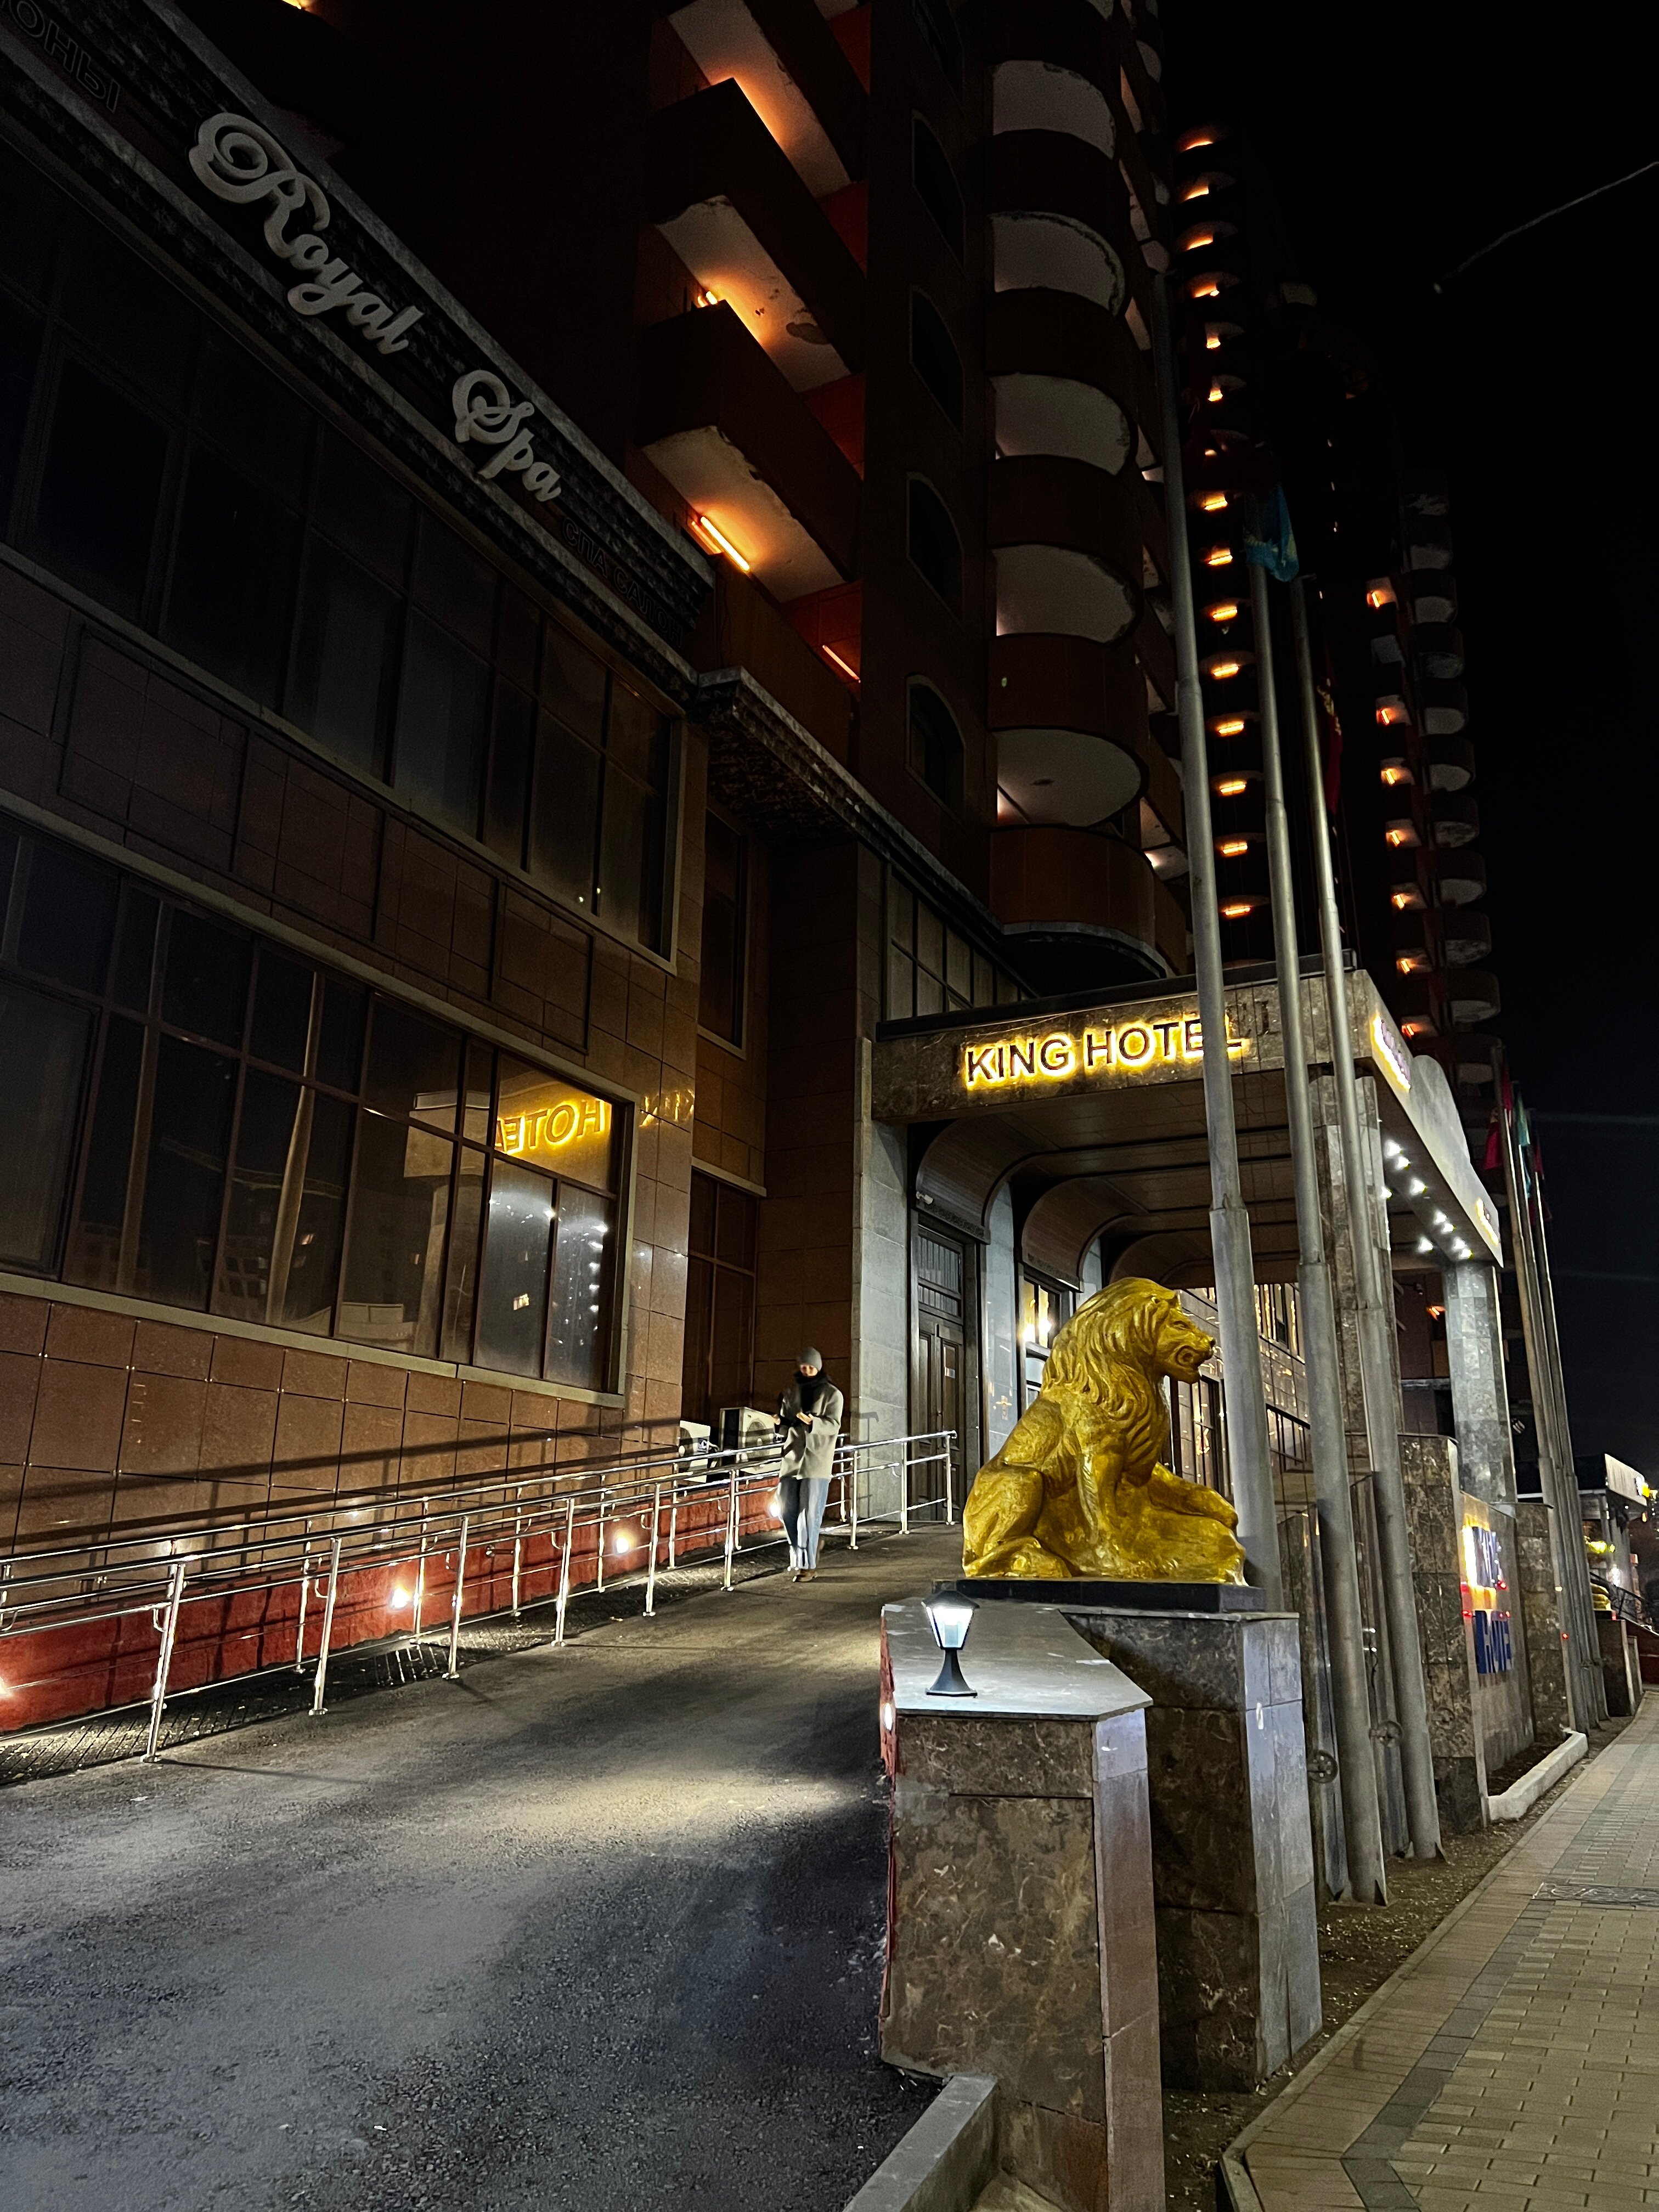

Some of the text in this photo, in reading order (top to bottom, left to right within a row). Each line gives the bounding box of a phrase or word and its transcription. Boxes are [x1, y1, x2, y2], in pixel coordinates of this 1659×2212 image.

[0, 0, 121, 114] ОНЫ
[188, 112, 562, 502] Royal Spa
[562, 517, 684, 648] СПА САЛОН
[967, 1039, 1069, 1082] KING
